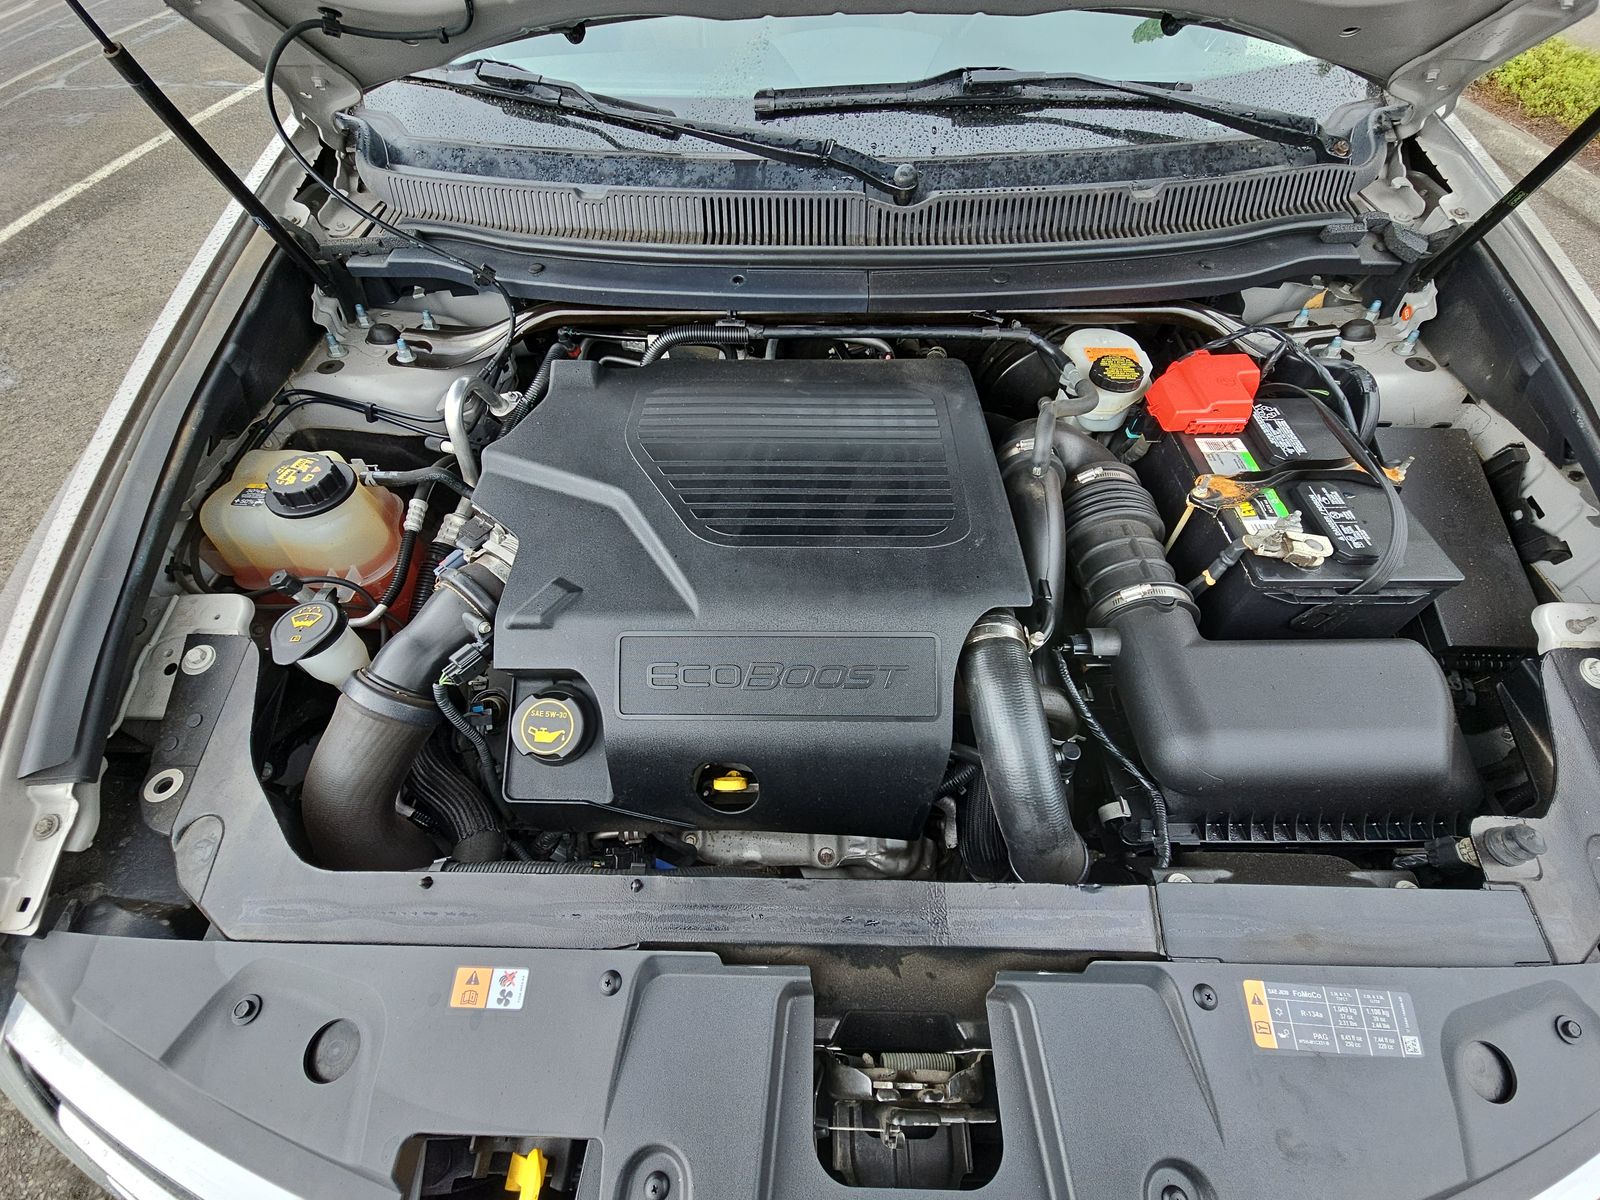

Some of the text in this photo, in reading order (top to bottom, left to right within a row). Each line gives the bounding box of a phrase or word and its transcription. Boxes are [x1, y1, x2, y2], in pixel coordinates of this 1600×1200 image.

[531, 709, 568, 719] SAE 5W-30
[1292, 989, 1322, 999] FoMoCo
[1300, 1009, 1324, 1018] R-134a
[1349, 1006, 1357, 1015] kg
[1381, 1009, 1390, 1017] kg
[1312, 1032, 1329, 1040] PAG
